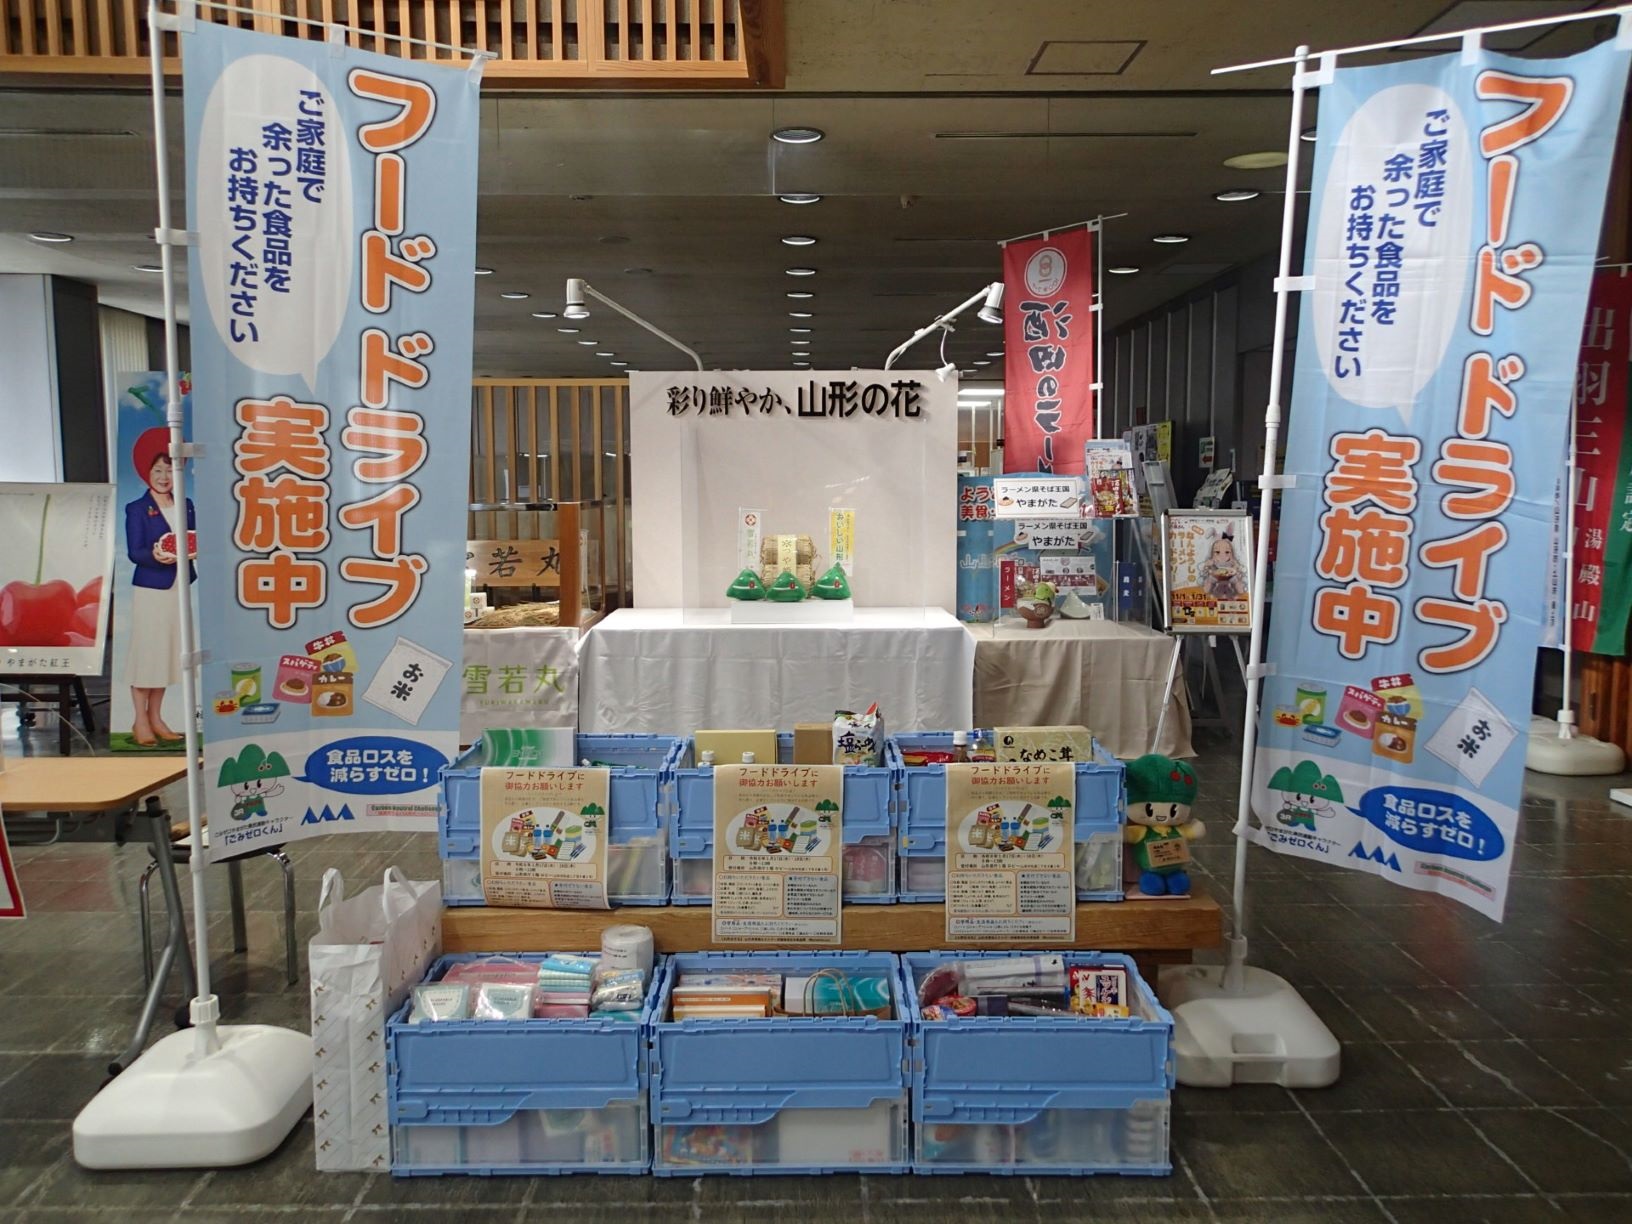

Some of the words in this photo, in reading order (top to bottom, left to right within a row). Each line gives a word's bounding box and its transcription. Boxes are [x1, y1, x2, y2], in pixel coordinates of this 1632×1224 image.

[296, 89, 326, 204] ご家庭で
[1413, 108, 1450, 228] ご家庭で
[262, 121, 293, 294] 余った食品を
[228, 147, 260, 344] お持ちください
[1371, 152, 1414, 326] 余った食品を
[1335, 184, 1377, 379] お持ちください
[339, 68, 437, 629] フードドライブ
[1415, 69, 1575, 675] フードドライブ
[666, 380, 922, 418] 彩り鮮やか、山形の花
[1001, 485, 1070, 494] ラーメン県そば王国
[1016, 498, 1058, 509] やまがた
[233, 396, 332, 630] 実施中
[1018, 522, 1088, 531] ラーメン県そば王国
[1032, 535, 1076, 547] やまがた
[1314, 428, 1422, 661] 実施中
[467, 546, 560, 578] 若丸
[1572, 527, 1603, 622] 湯殿山
[7, 658, 71, 668] やまがた紅王
[318, 675, 346, 684] カレー
[390, 663, 425, 702] お米
[462, 664, 565, 695] 雪若丸
[1381, 714, 1409, 727] カレー
[1456, 719, 1492, 758] お米
[327, 750, 414, 765] 食品ロスを
[739, 767, 819, 777] フードドライブに
[971, 766, 1051, 775] フードドライブに
[505, 771, 585, 780] フードドライブに
[505, 782, 584, 791] 御協力お願いします
[739, 779, 819, 788] 御協力お願いします
[971, 776, 1051, 785] 御協力お願いします
[1279, 812, 1292, 821] 3R
[1383, 793, 1473, 830] 食品ロスを
[224, 825, 284, 846] 「ごみゼロくん」
